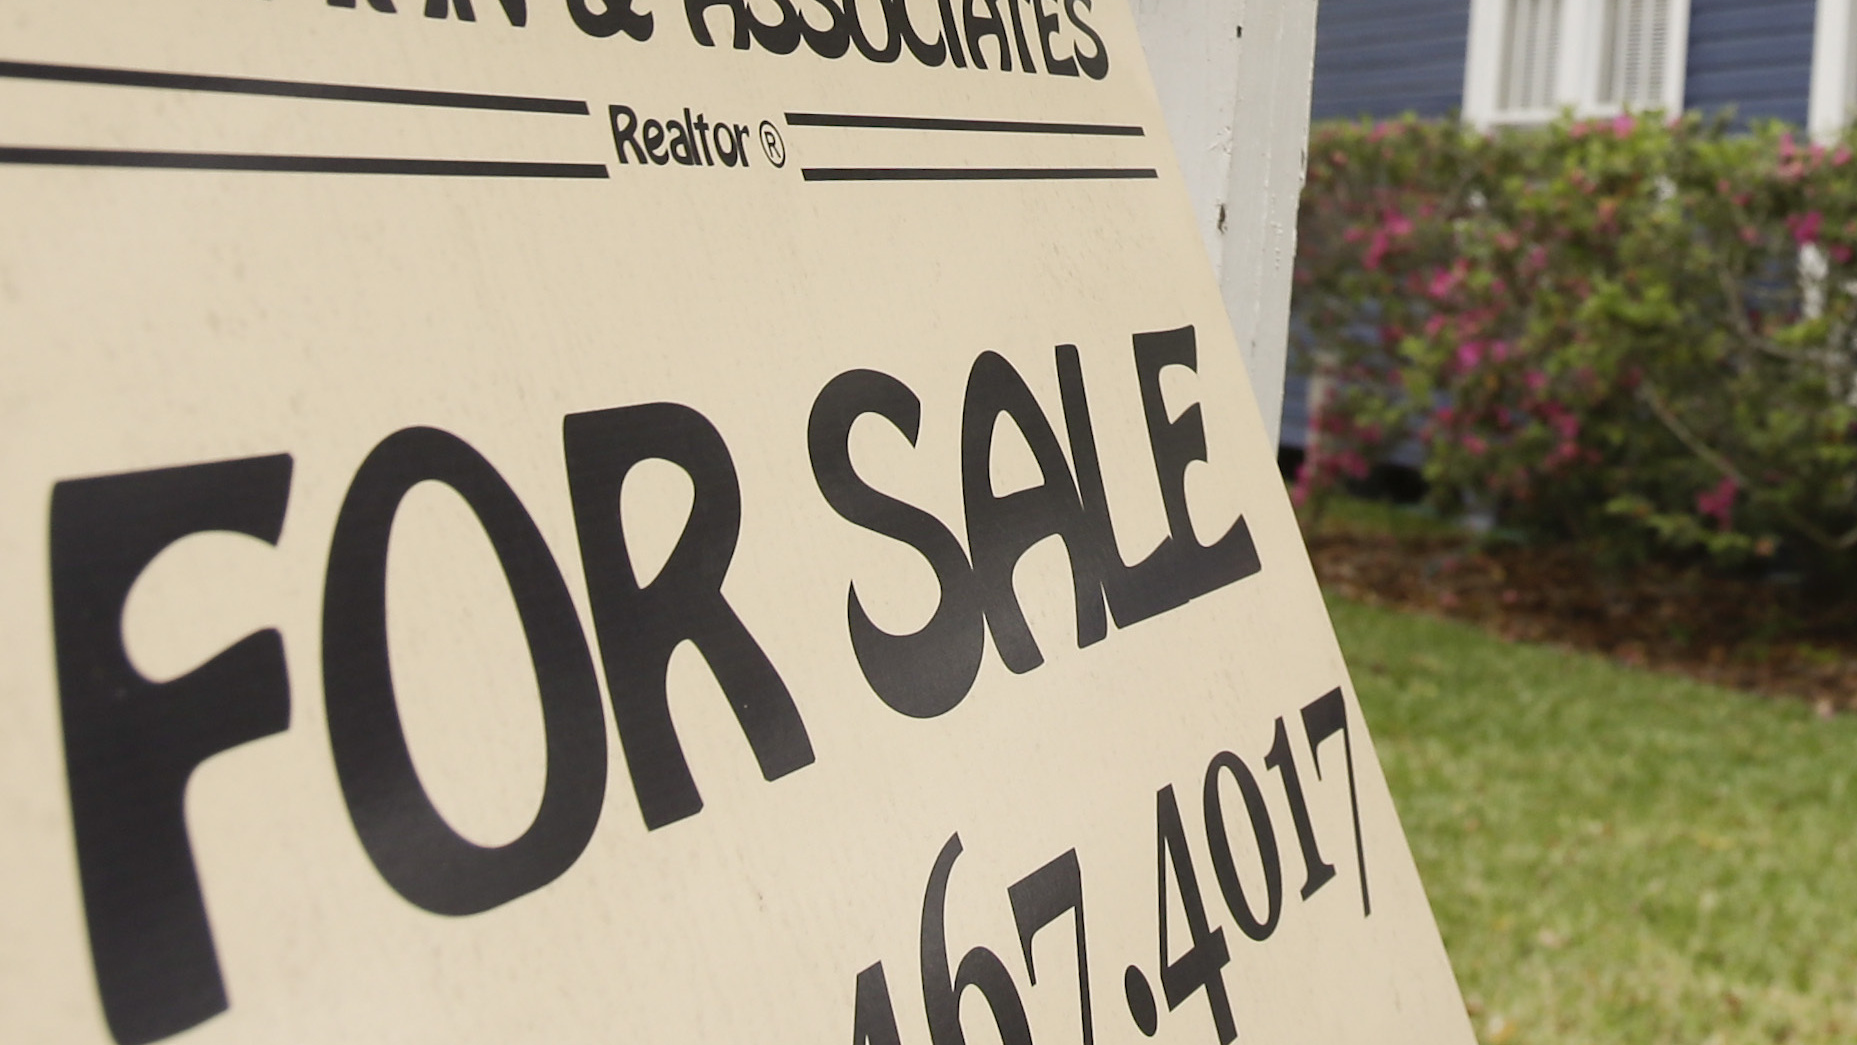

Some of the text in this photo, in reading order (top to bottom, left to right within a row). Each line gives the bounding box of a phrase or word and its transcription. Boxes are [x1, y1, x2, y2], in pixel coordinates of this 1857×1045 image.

[608, 104, 751, 168] Realtor
[48, 324, 1262, 1045] FOR SALE
[852, 686, 1371, 1045] 67.4017
